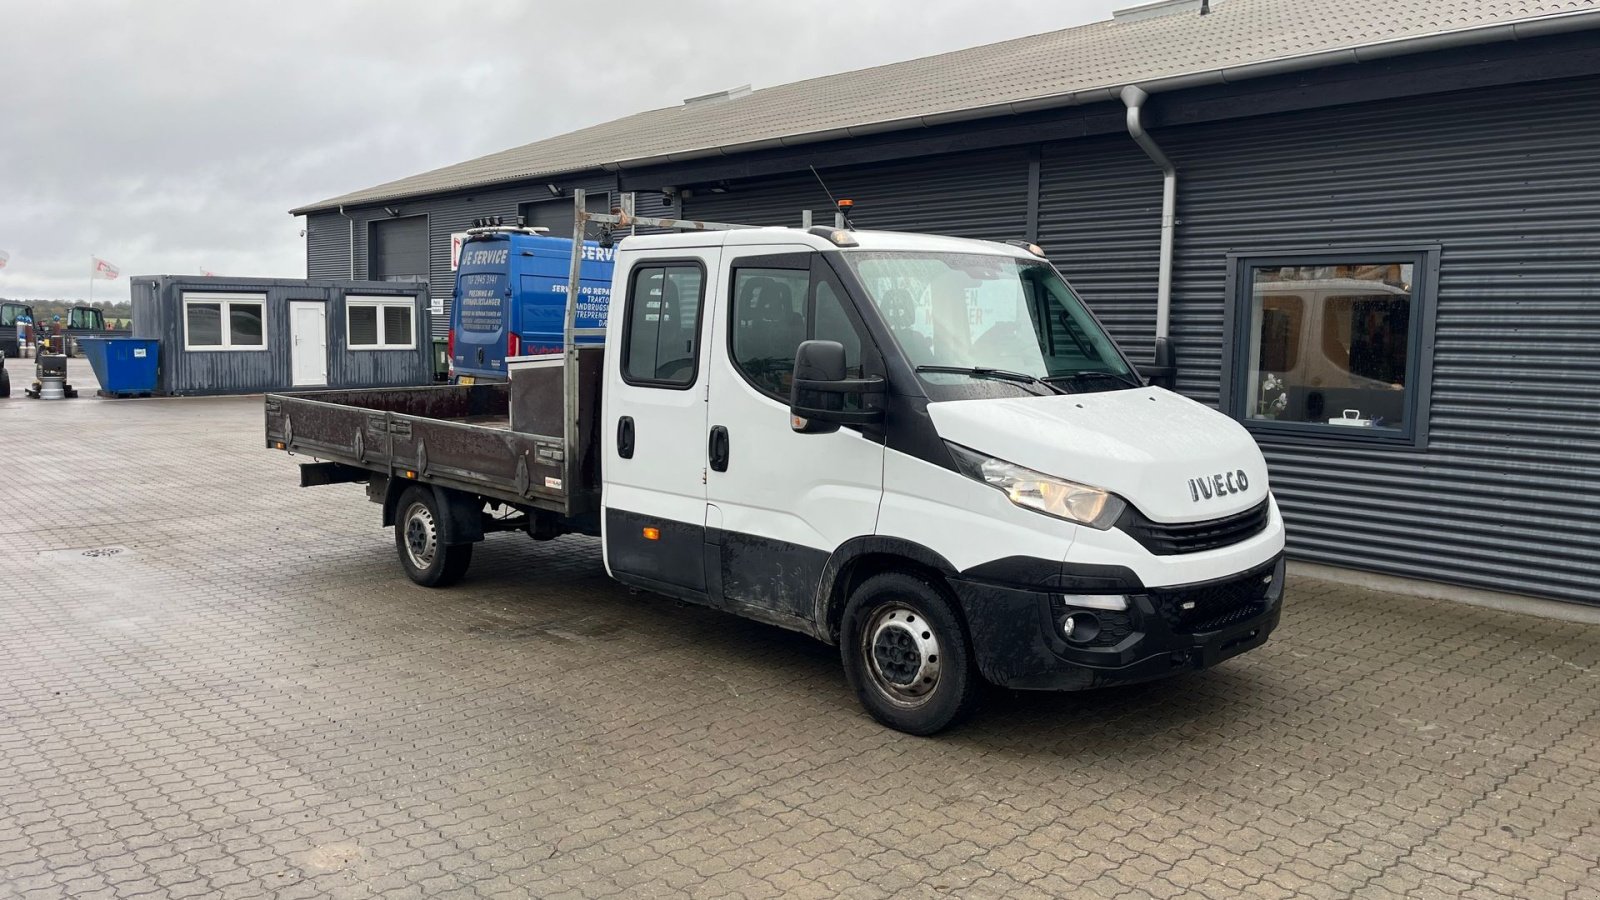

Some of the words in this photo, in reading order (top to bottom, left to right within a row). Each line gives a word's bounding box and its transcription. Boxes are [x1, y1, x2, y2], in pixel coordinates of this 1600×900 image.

[462, 251, 473, 265] JE
[473, 249, 508, 265] SERVICE
[1187, 469, 1249, 502] IVECO
